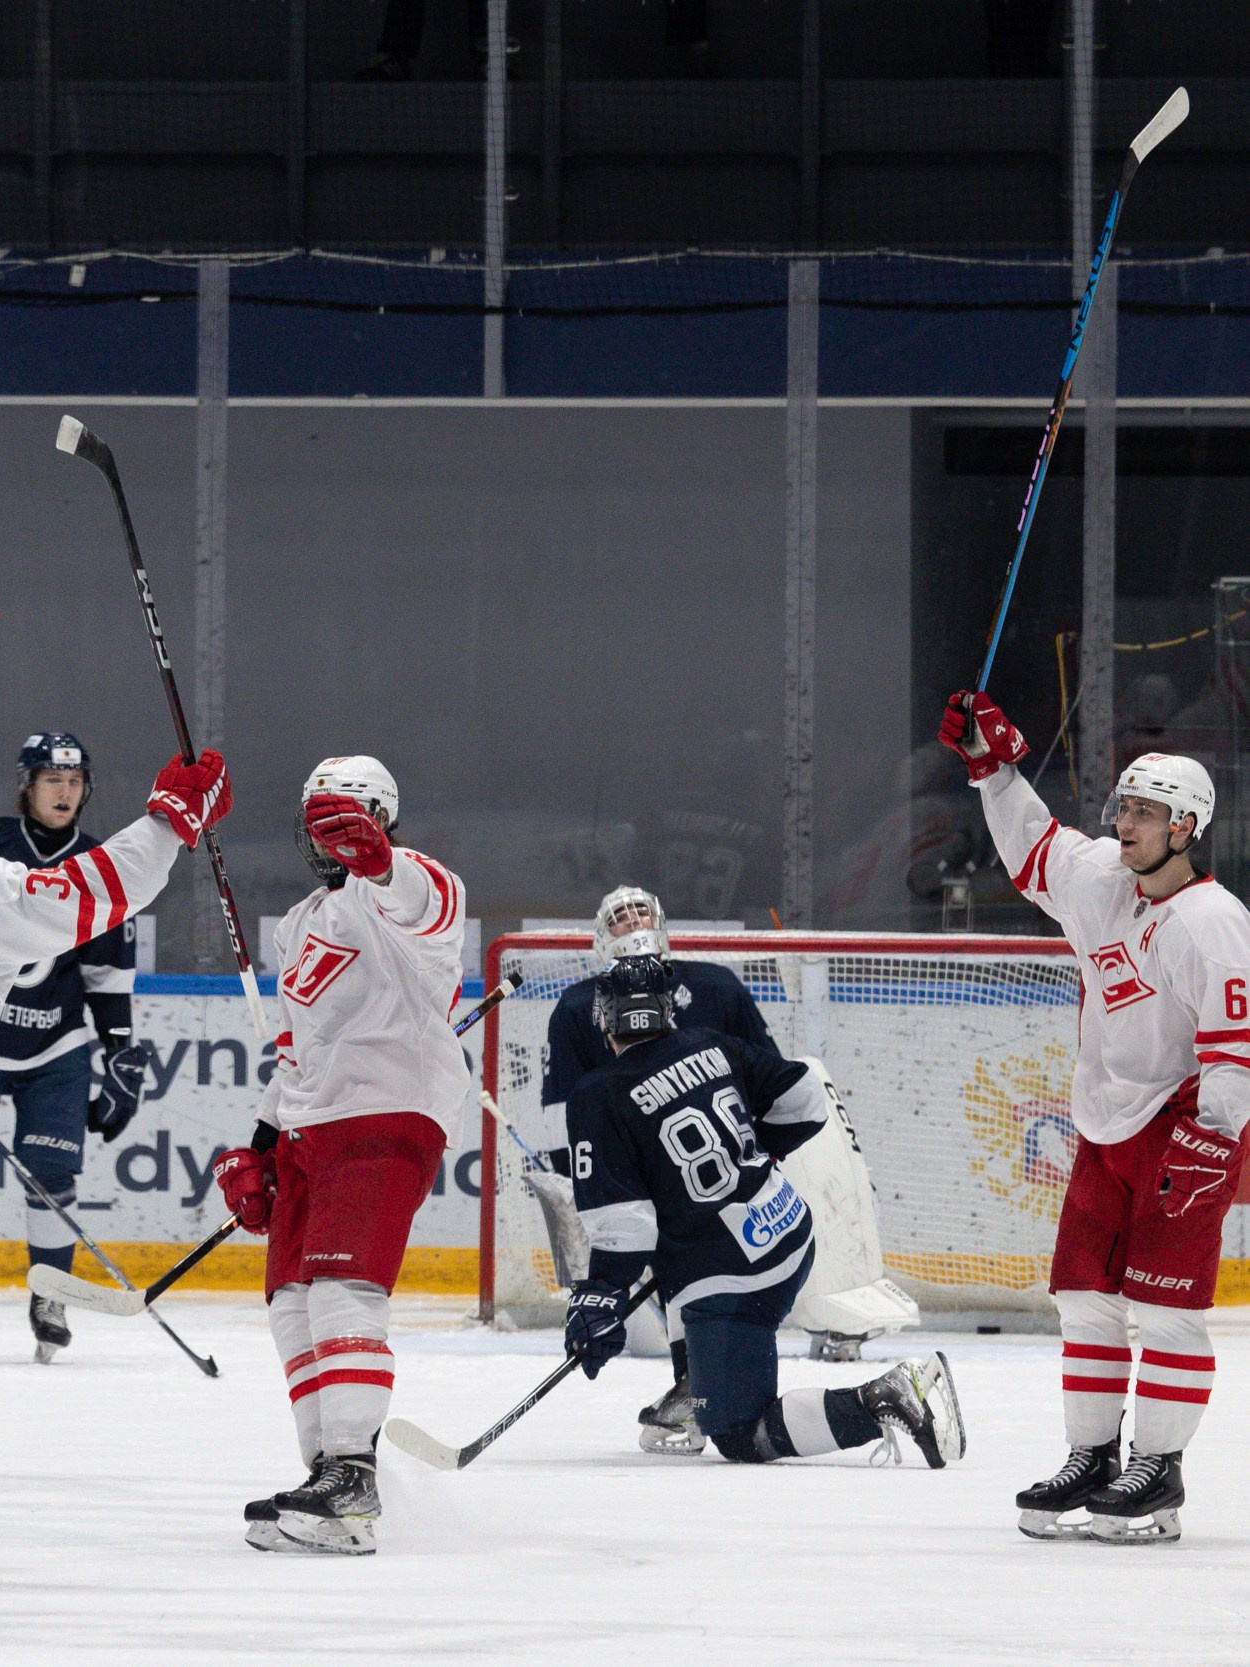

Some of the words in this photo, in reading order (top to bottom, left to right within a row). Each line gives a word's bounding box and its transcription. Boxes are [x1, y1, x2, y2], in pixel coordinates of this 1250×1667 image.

[26, 867, 71, 900] 3
[633, 936, 649, 951] 32
[1139, 920, 1158, 954] A
[629, 1013, 650, 1030] 86
[629, 1046, 733, 1116] SINYATKIN
[568, 1140, 593, 1180] 6
[658, 1085, 770, 1203] 86
[1125, 1266, 1194, 1291] BAUER
[568, 1293, 618, 1310] UER
